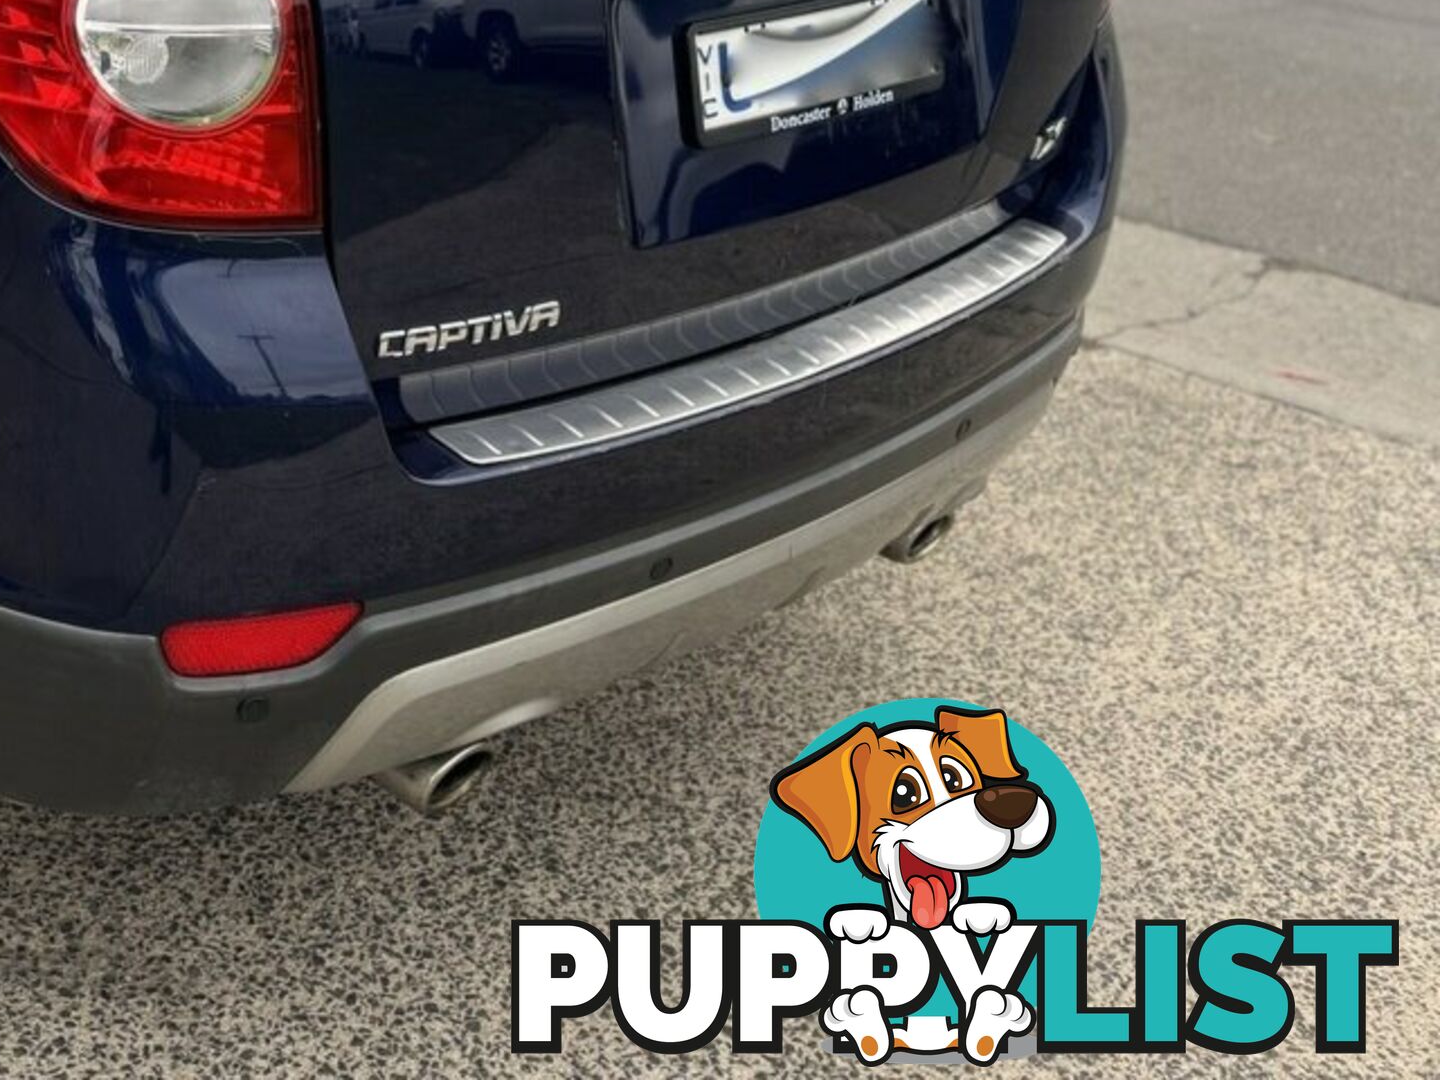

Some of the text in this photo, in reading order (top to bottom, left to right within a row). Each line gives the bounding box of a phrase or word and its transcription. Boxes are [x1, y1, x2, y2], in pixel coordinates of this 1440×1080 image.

[770, 89, 893, 132] Doncaster Holden
[377, 300, 561, 358] CAPTIVA
